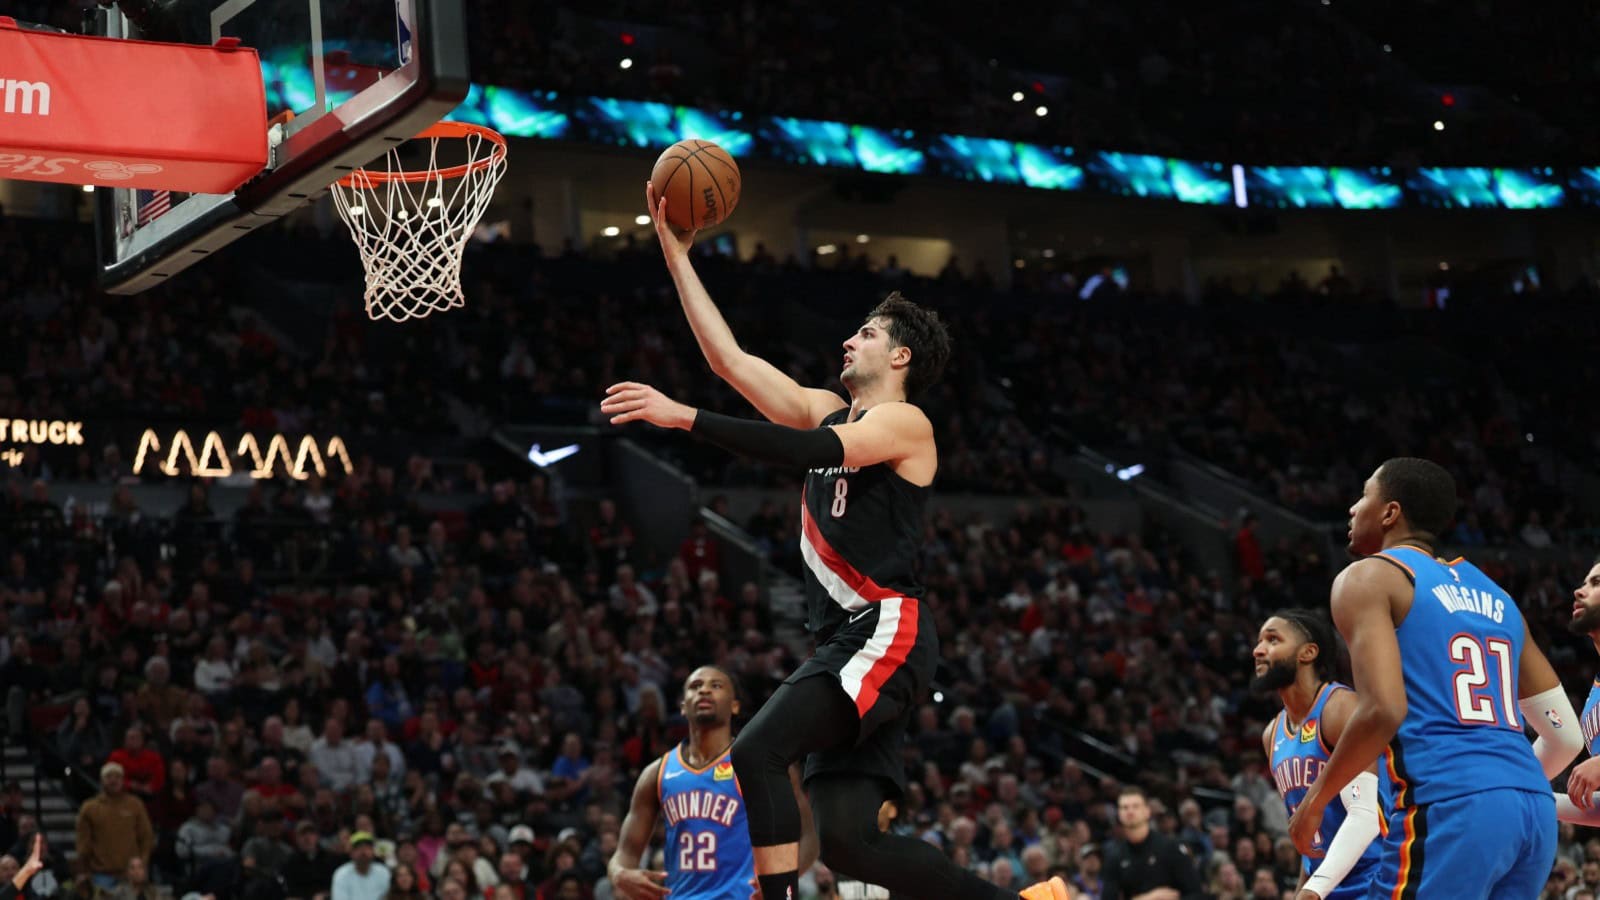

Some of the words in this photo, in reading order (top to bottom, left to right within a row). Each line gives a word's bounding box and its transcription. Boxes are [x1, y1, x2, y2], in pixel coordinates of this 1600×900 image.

[0, 418, 84, 445] TRUCK
[831, 477, 848, 518] 8
[1431, 583, 1505, 624] WIGGINS
[1449, 633, 1521, 731] 21
[679, 831, 717, 871] 22
